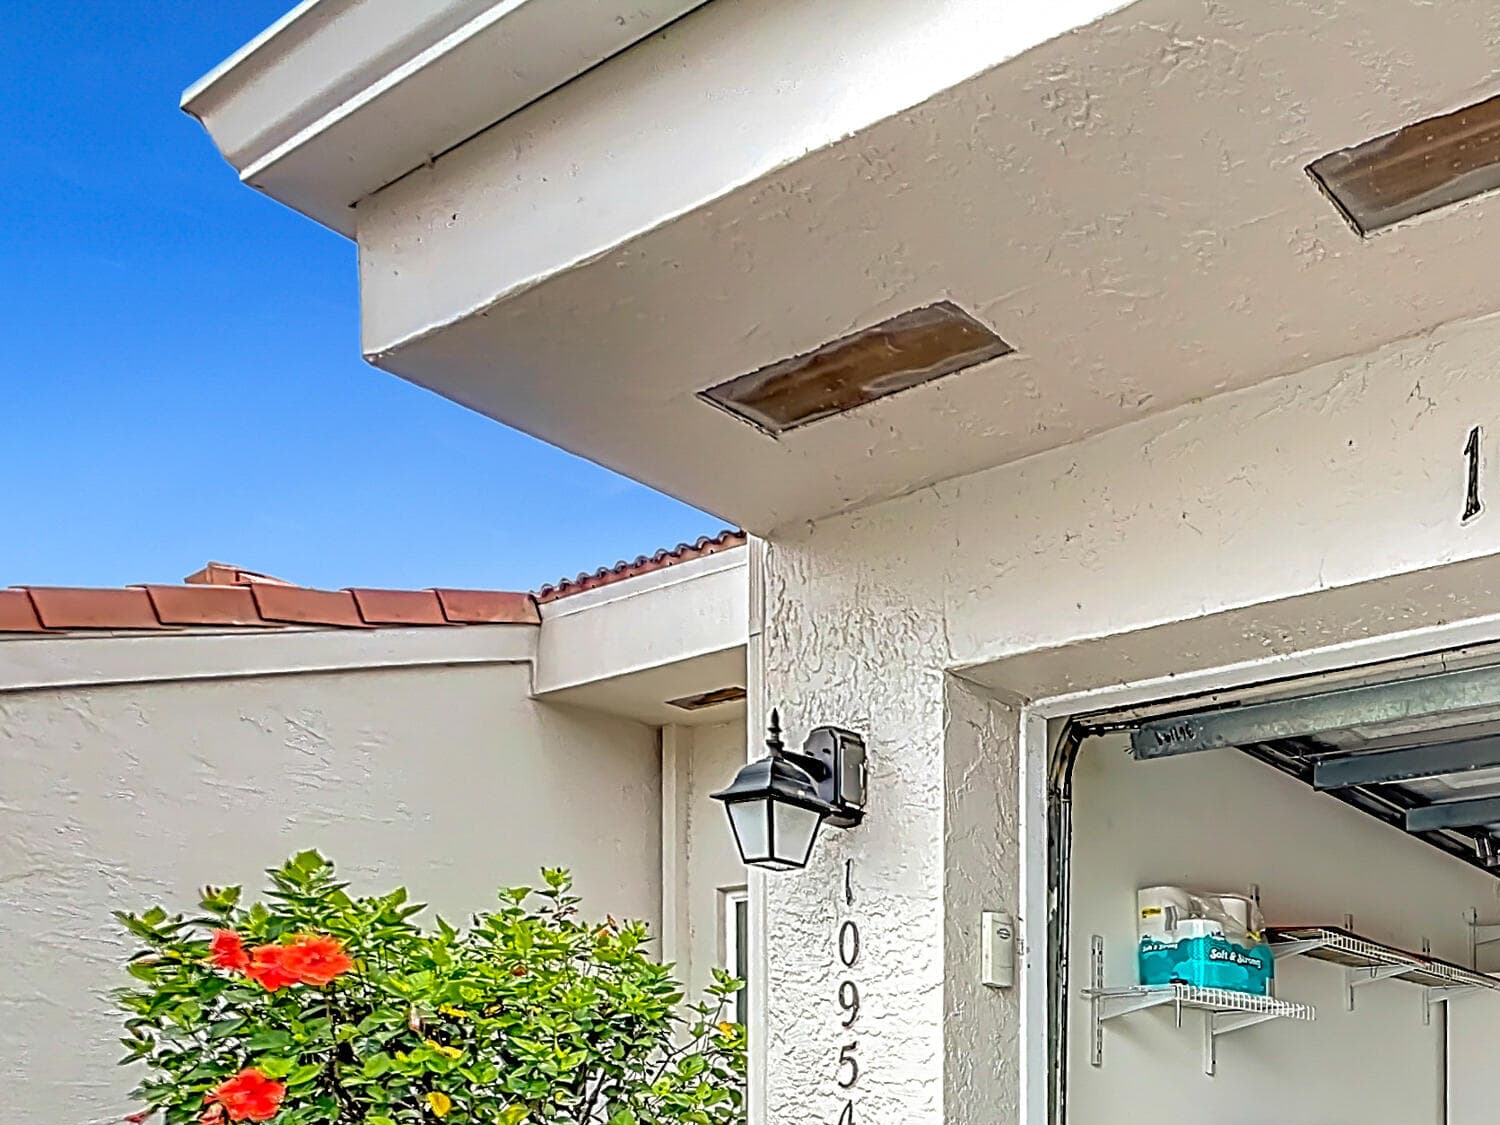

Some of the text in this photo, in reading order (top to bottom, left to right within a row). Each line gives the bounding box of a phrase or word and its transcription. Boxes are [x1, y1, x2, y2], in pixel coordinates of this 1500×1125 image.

[1209, 948, 1262, 969] Soft & Strong
